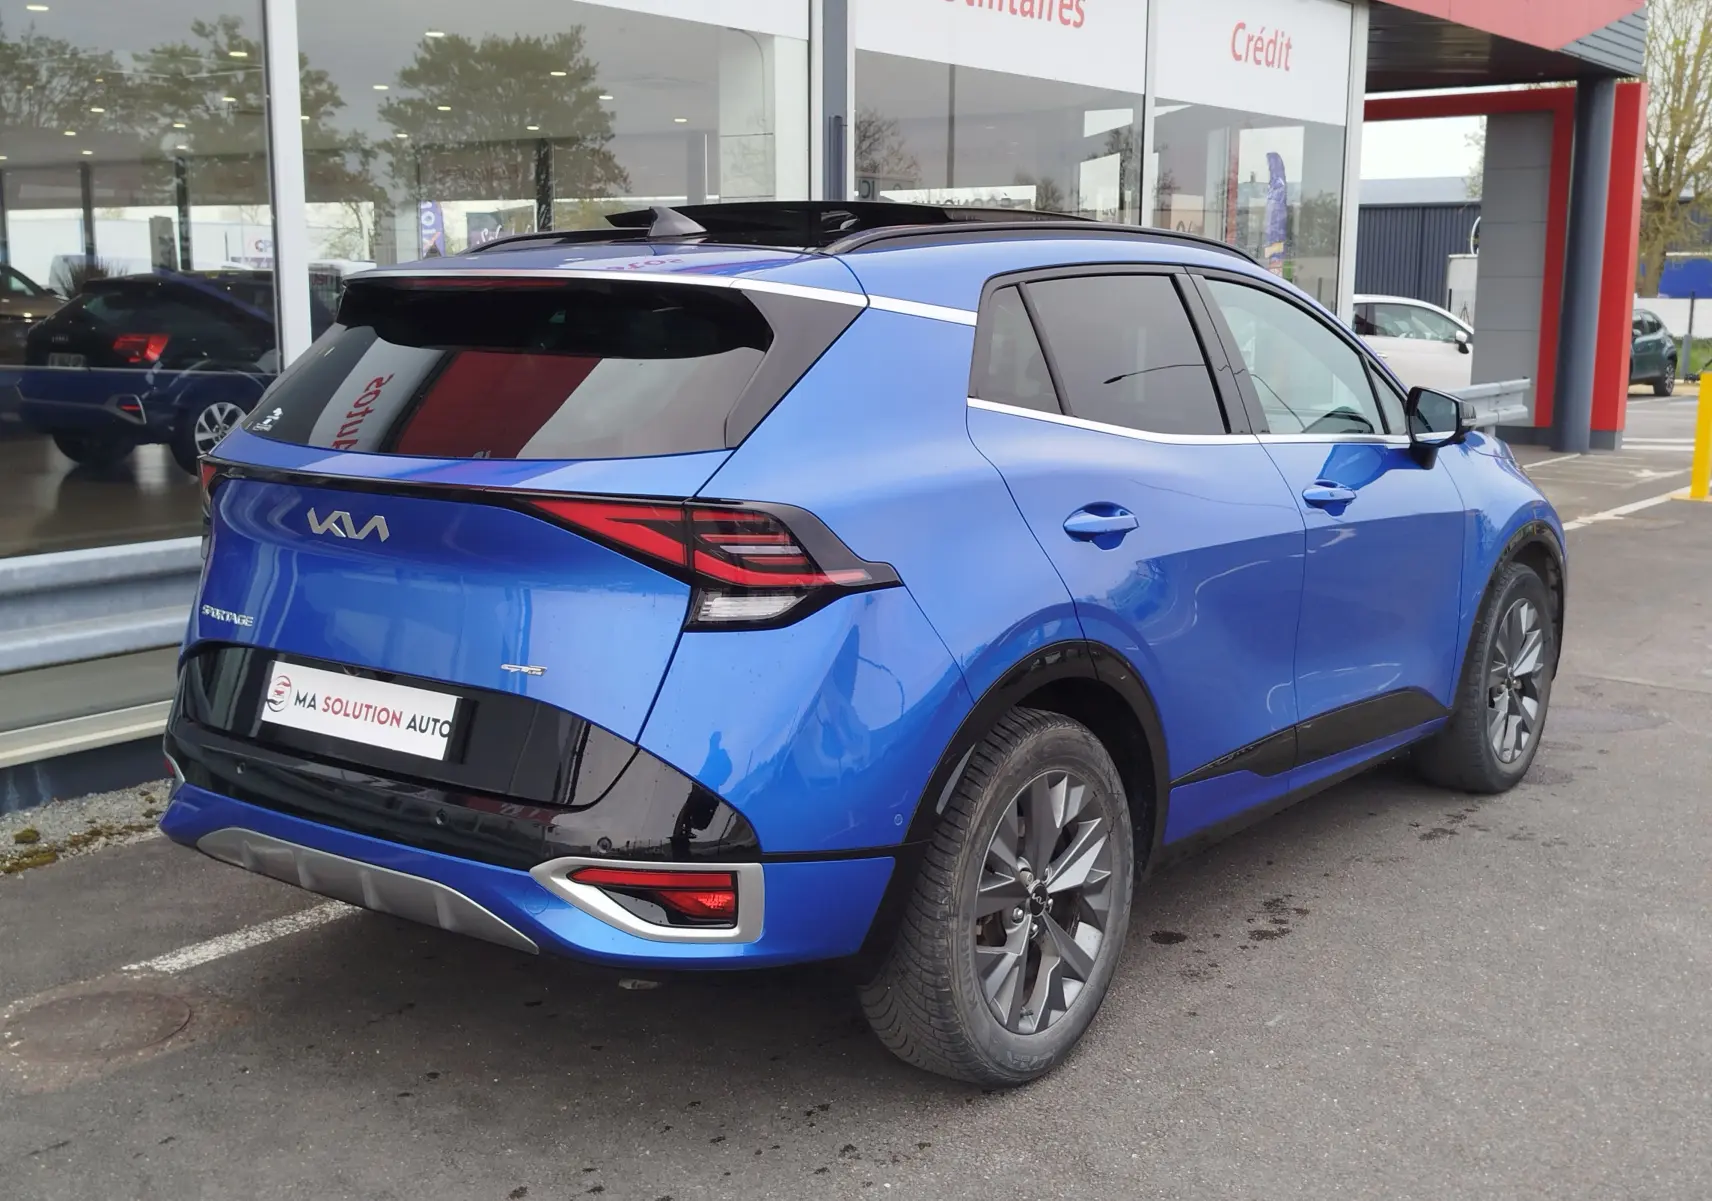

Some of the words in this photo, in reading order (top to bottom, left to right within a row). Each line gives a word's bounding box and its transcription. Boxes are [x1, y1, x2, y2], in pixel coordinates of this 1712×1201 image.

[1231, 22, 1292, 71] Crédit
[307, 507, 390, 543] KIA
[294, 689, 317, 711] MA
[322, 695, 404, 728] SOLUTION
[406, 713, 453, 739] AUTO
